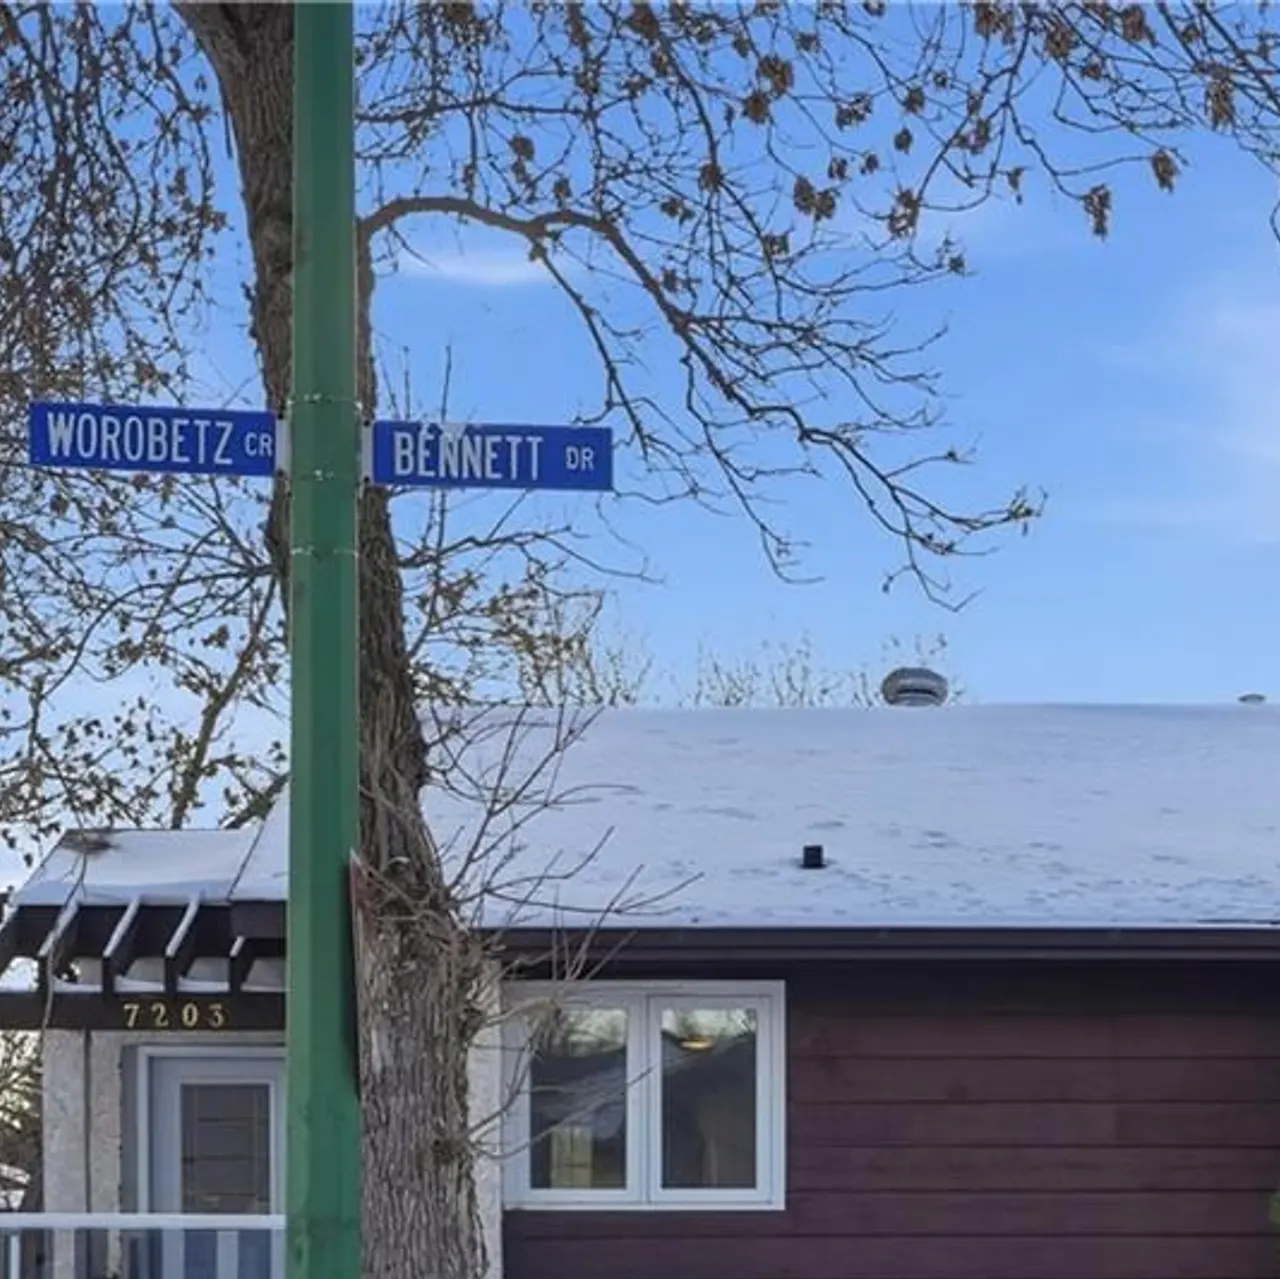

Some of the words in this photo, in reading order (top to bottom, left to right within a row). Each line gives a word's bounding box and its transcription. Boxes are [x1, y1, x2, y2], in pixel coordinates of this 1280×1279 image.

[47, 412, 234, 465] WOROBETZ
[244, 431, 273, 458] CR
[393, 422, 543, 481] BENNETT
[565, 445, 595, 471] DR
[123, 1002, 224, 1028] 7203
